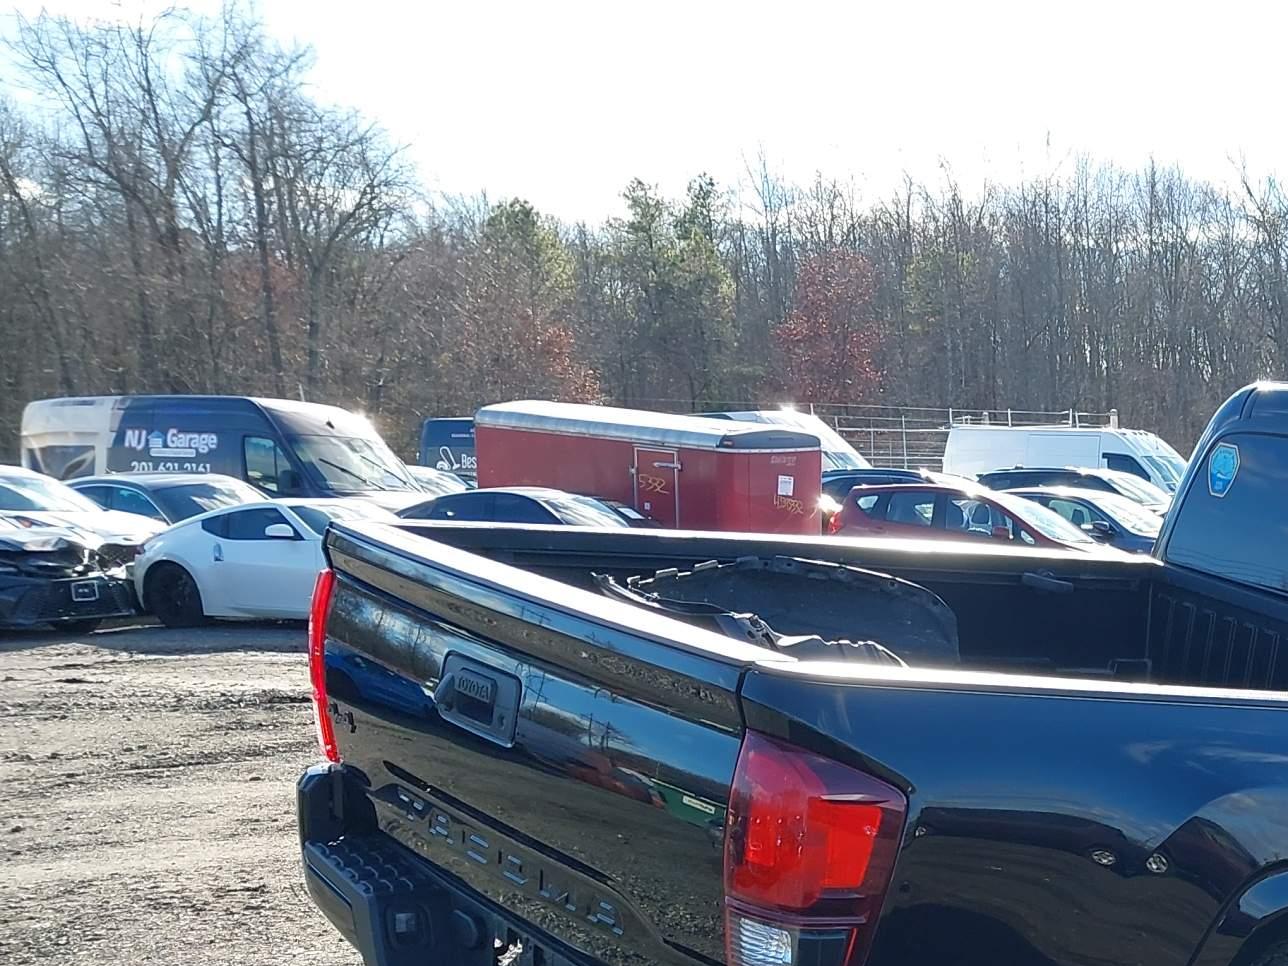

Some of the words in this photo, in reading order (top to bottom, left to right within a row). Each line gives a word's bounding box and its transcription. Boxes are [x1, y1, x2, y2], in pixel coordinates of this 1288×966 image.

[124, 429, 147, 451] NJ
[166, 428, 217, 453] Garage
[457, 675, 492, 700] TOYOTA
